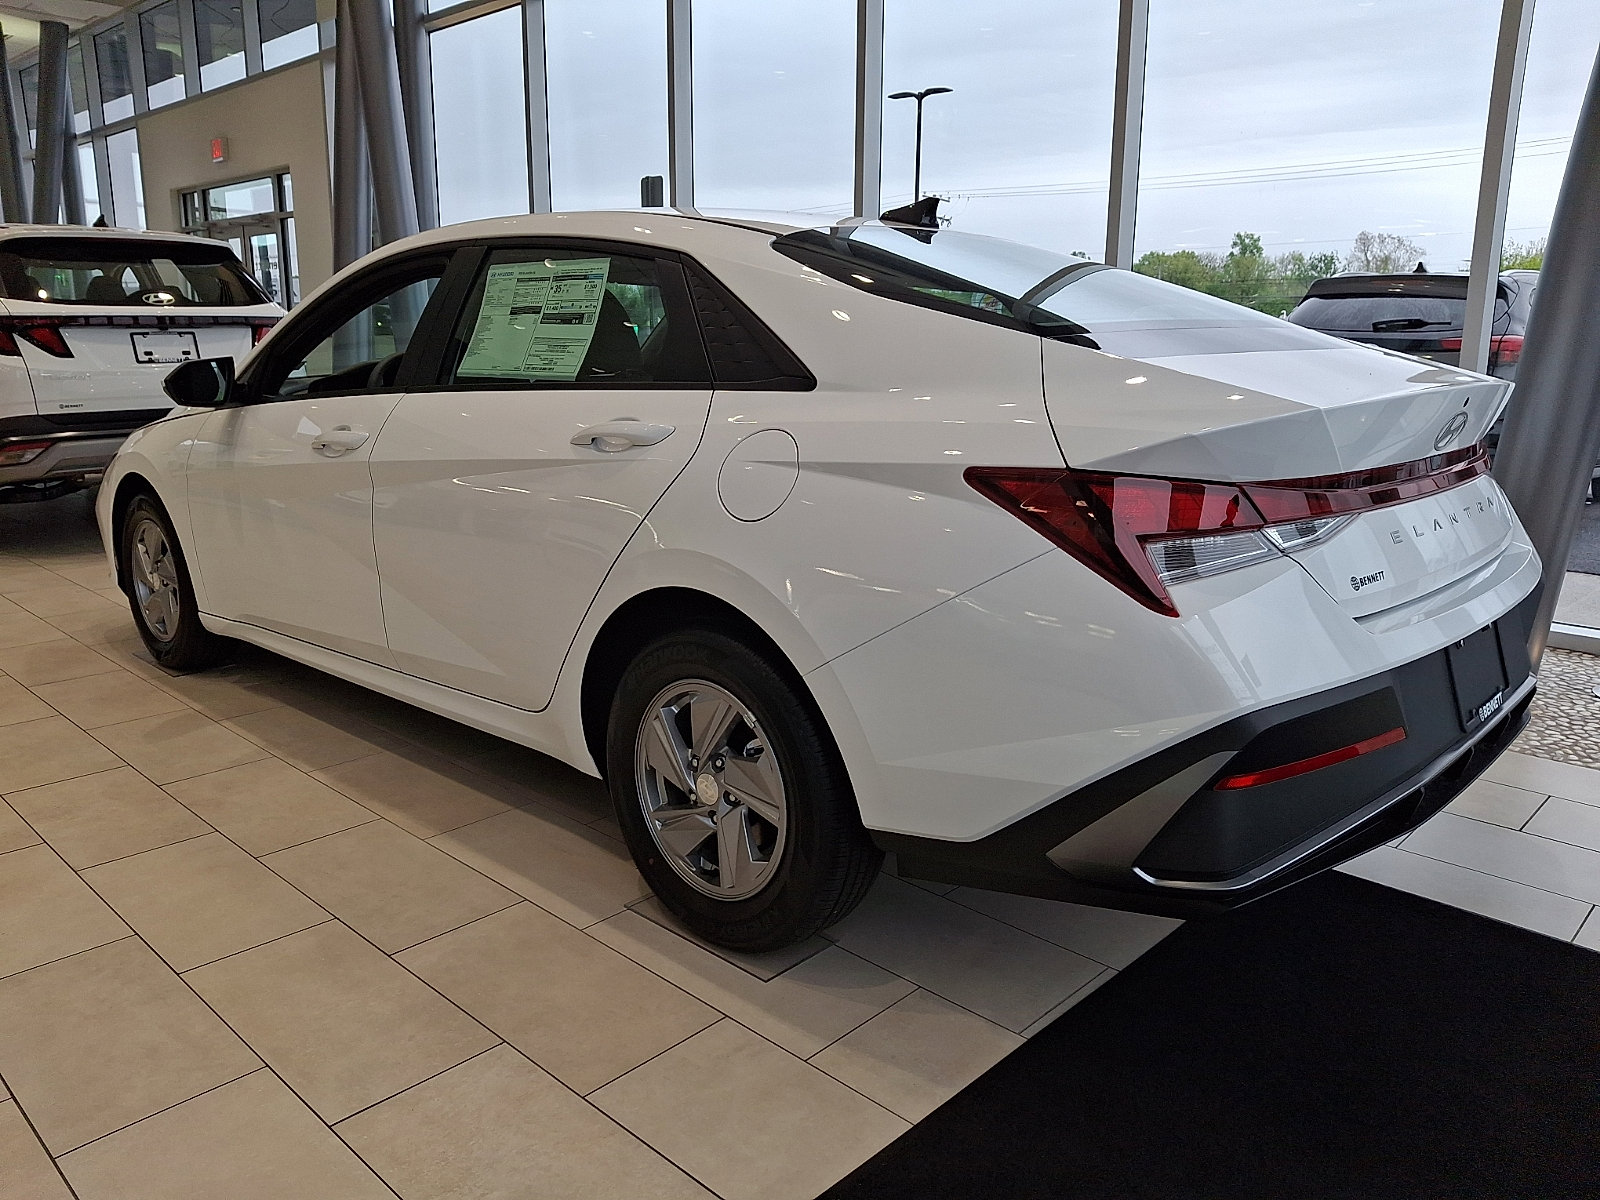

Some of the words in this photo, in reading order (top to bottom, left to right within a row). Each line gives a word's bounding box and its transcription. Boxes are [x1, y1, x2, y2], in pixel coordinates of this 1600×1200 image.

[1389, 496, 1495, 545] ELANTRA
[1359, 570, 1385, 587] BENNETT
[1483, 691, 1503, 719] BENNETT
